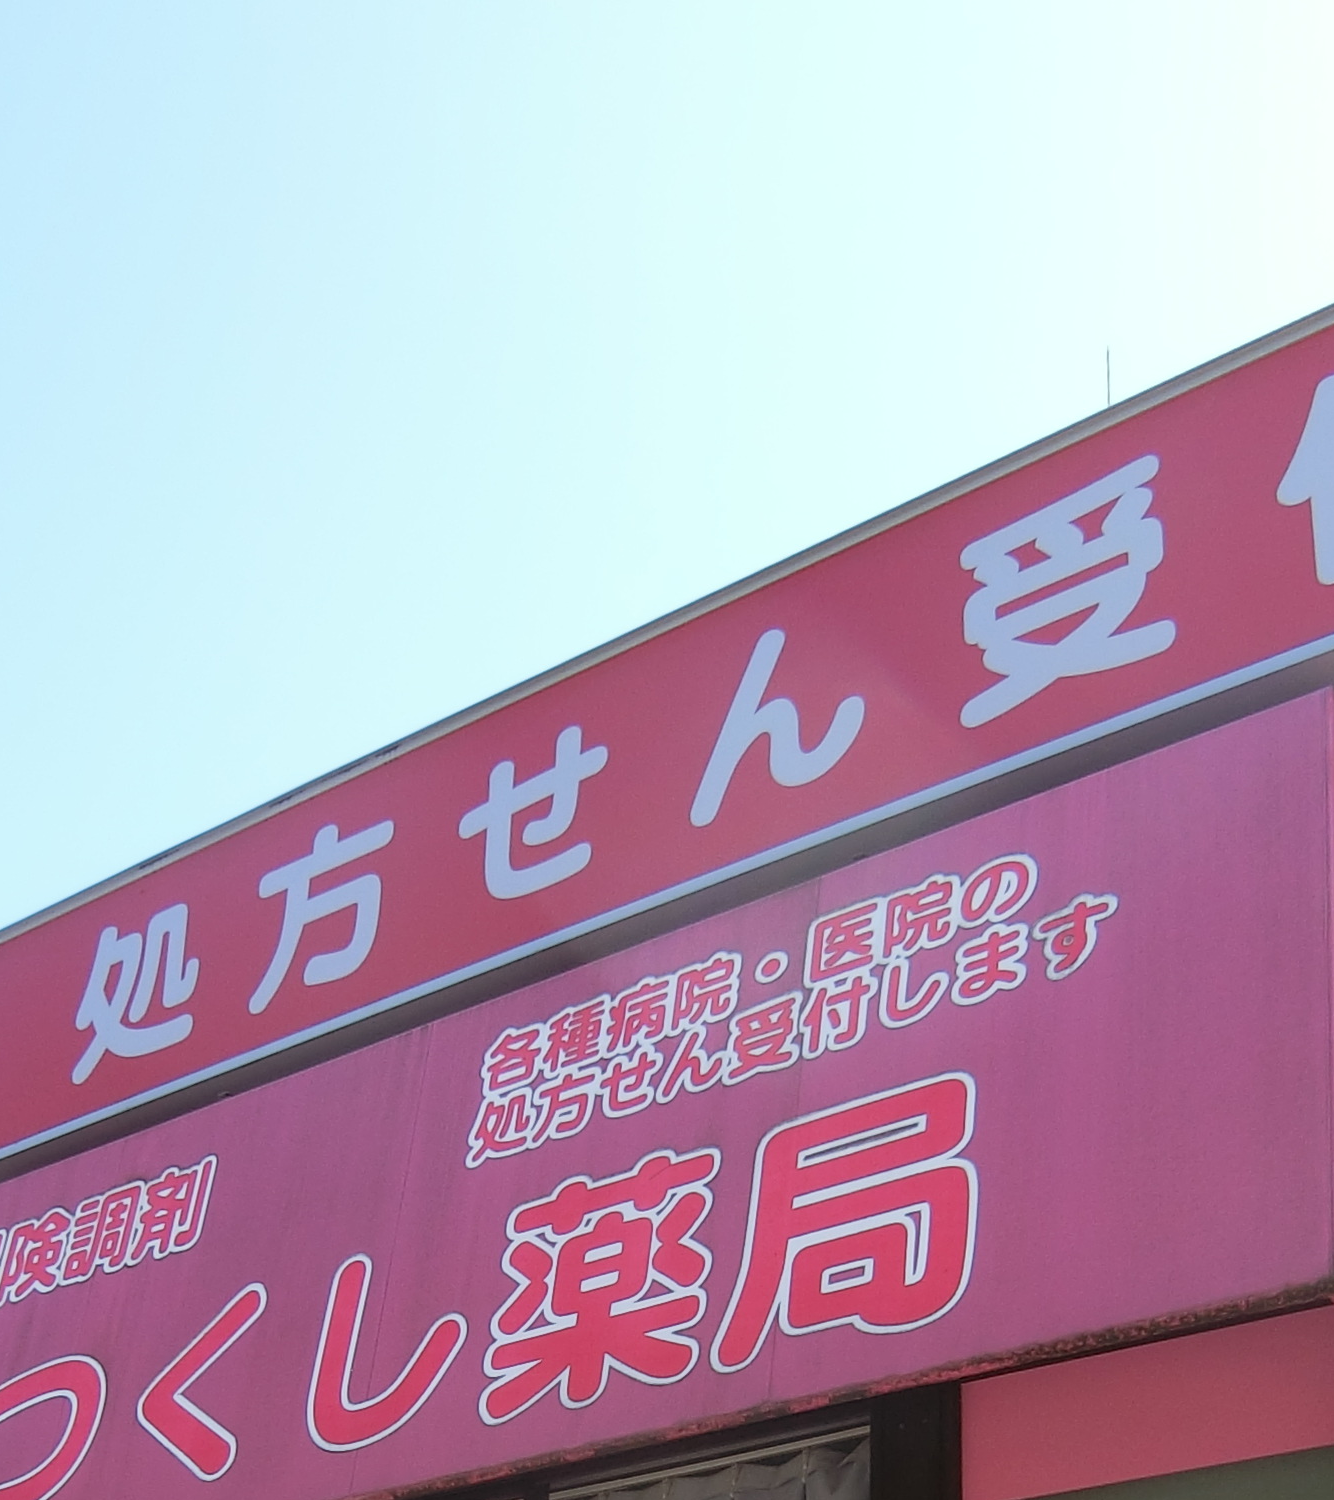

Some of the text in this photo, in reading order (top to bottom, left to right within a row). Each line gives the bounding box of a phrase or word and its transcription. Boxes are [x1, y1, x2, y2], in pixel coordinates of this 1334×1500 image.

[466, 893, 1117, 1168] 処方せん受付します
[482, 852, 1038, 1092] 各種病院・医院の
